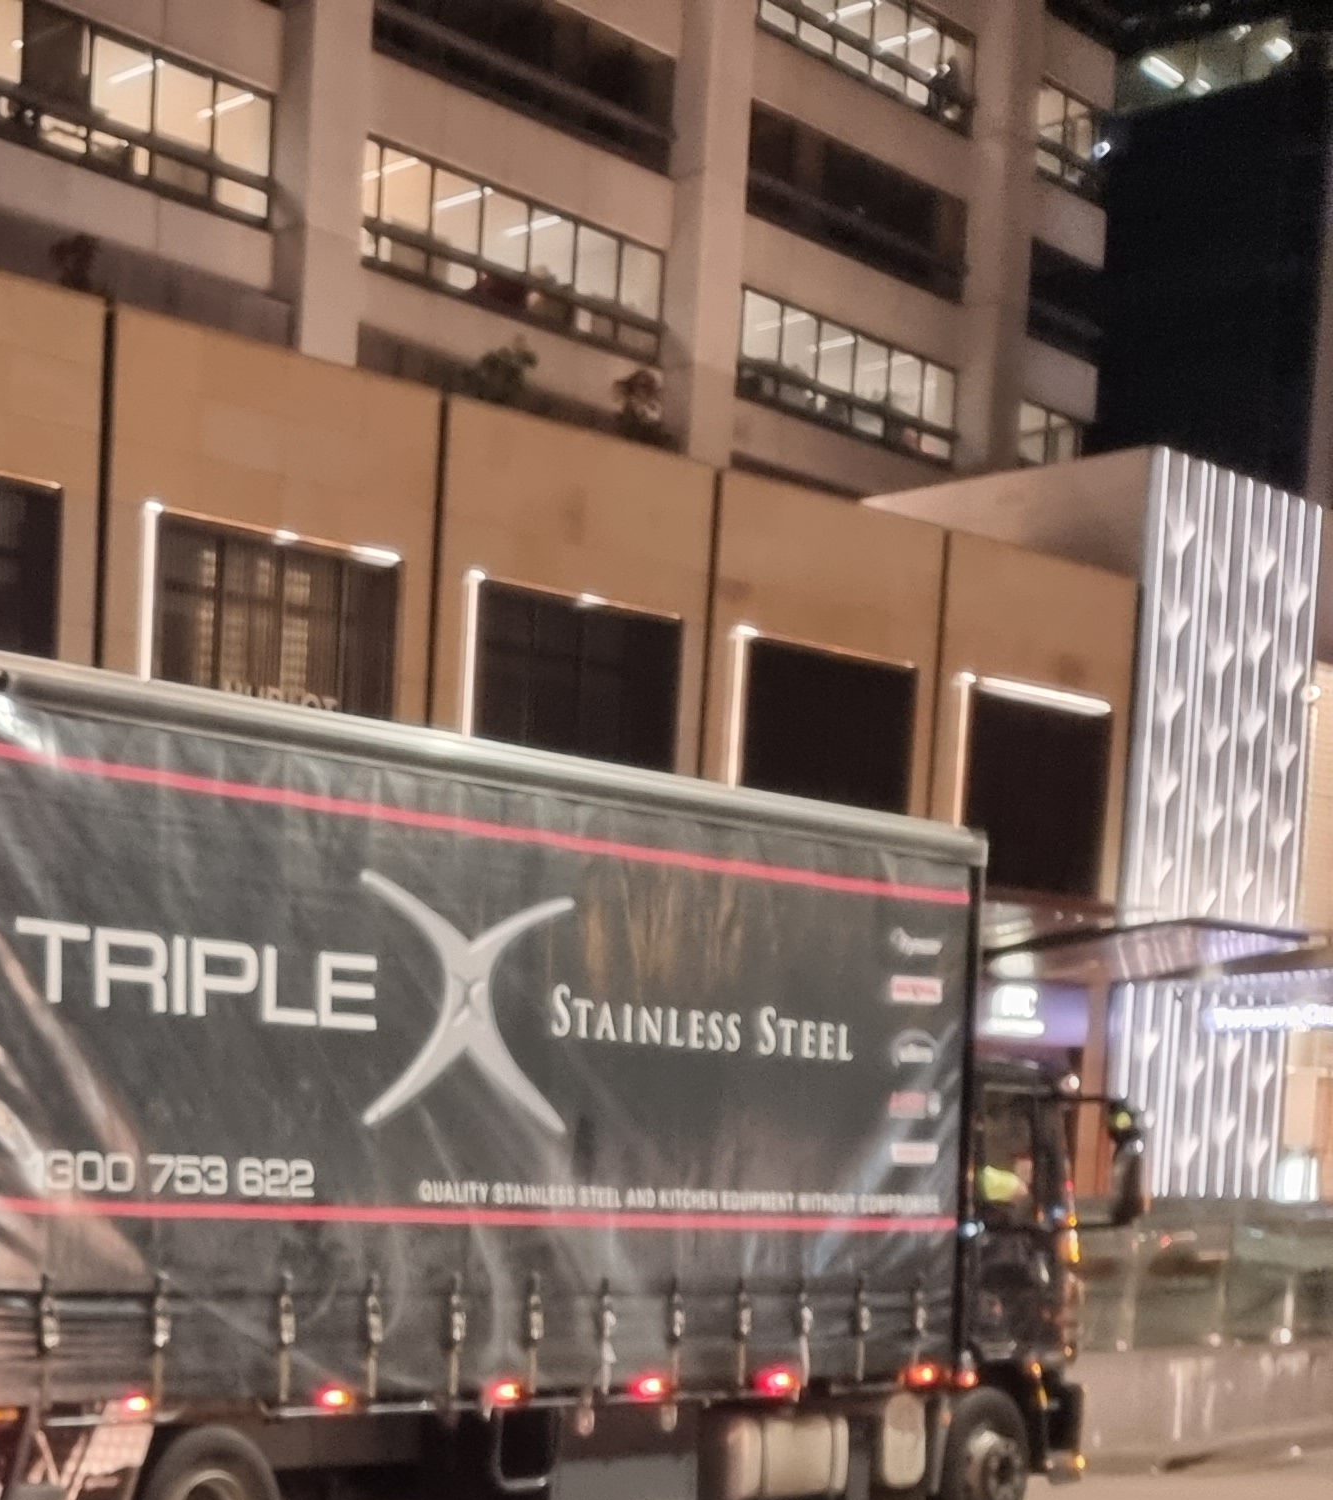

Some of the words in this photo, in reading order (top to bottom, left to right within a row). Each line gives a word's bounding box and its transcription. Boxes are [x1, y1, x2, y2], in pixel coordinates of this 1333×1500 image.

[15, 916, 378, 1031] TRIPLE
[36, 1149, 136, 1193] 300
[148, 1154, 228, 1195] 753
[237, 1157, 315, 1198] 622
[418, 1178, 489, 1203] QUALITY
[491, 1181, 575, 1207] STAINLESS
[578, 1185, 622, 1208] STEEL
[625, 1187, 656, 1209] AND
[658, 1187, 718, 1210] KITCHEN
[720, 1189, 794, 1213] EQUIPMENT
